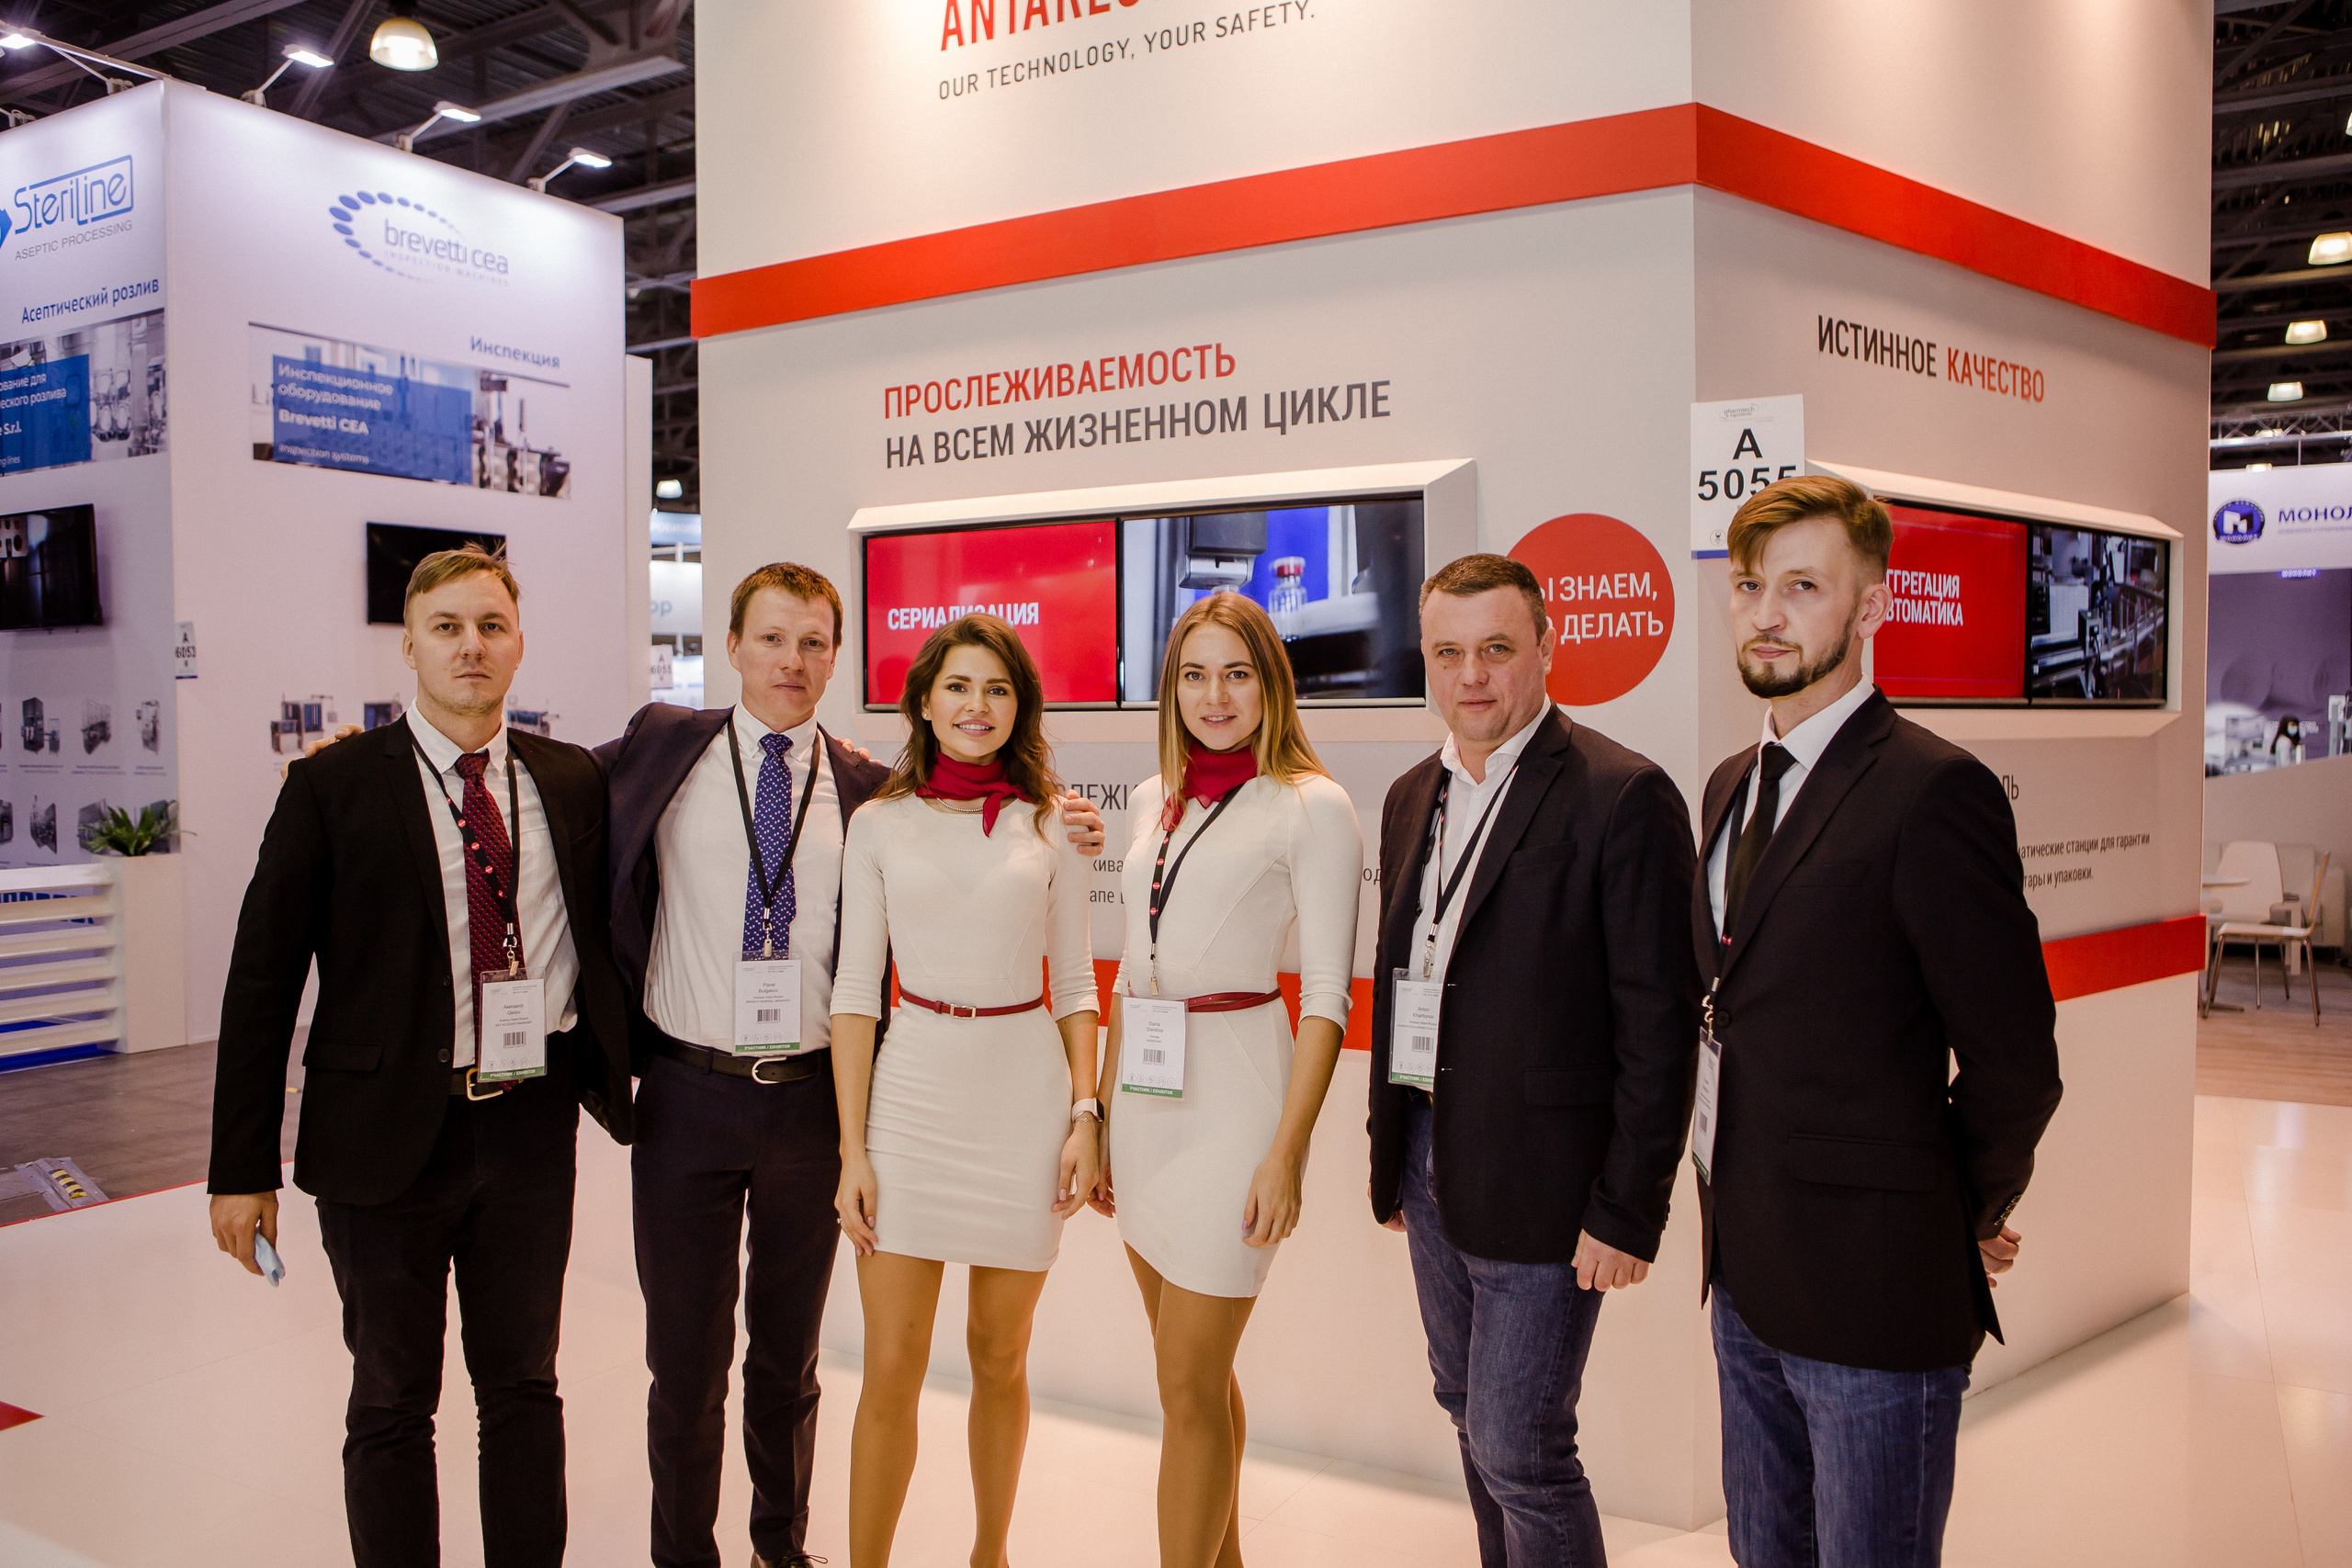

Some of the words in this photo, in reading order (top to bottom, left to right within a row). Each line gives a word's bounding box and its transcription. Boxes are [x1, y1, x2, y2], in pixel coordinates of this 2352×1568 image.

[941, 0, 1142, 51] ANTA
[940, 73, 978, 100] OUR
[987, 38, 1136, 89] TECHNOLOGY,
[1144, 21, 1206, 53] YOUR
[1216, 0, 1315, 39] SAFETY.
[15, 241, 59, 261] ASEPTIC
[62, 220, 133, 248] PROCESSING
[383, 218, 468, 265] brevetti
[473, 248, 509, 275] cea
[22, 286, 108, 324] Асептический
[113, 278, 159, 307] розлив
[470, 335, 560, 368] Инспекция
[1818, 315, 1937, 378] ИСТИННОЕ
[1948, 347, 2045, 402] КАЧЕСТВО
[30, 374, 47, 387] для
[277, 363, 393, 396] Инспекционное
[885, 343, 1237, 419] ПРОСЛЕЖИВАЕМОСТЬ
[30, 388, 66, 406] розлива
[277, 382, 381, 412] оборудование
[278, 408, 336, 430] Brevetti
[338, 417, 369, 434] CEA
[886, 436, 925, 468] НА
[933, 423, 1014, 464] ВСЕМ
[1024, 395, 1248, 455] ЖИЗНЕННОМ
[1264, 379, 1391, 435] ЦИКЛЕ
[1559, 571, 1657, 602] ЗНАЕМ,
[1883, 568, 1960, 603] ГГРЕГАЦИЯ
[1560, 611, 1664, 645] ДЕЛАТЬ
[2065, 837, 2099, 855] станции
[2100, 836, 2115, 853] для
[2116, 833, 2151, 852] гарантии
[2047, 872, 2052, 885] и
[2054, 867, 2094, 888] упаковки.
